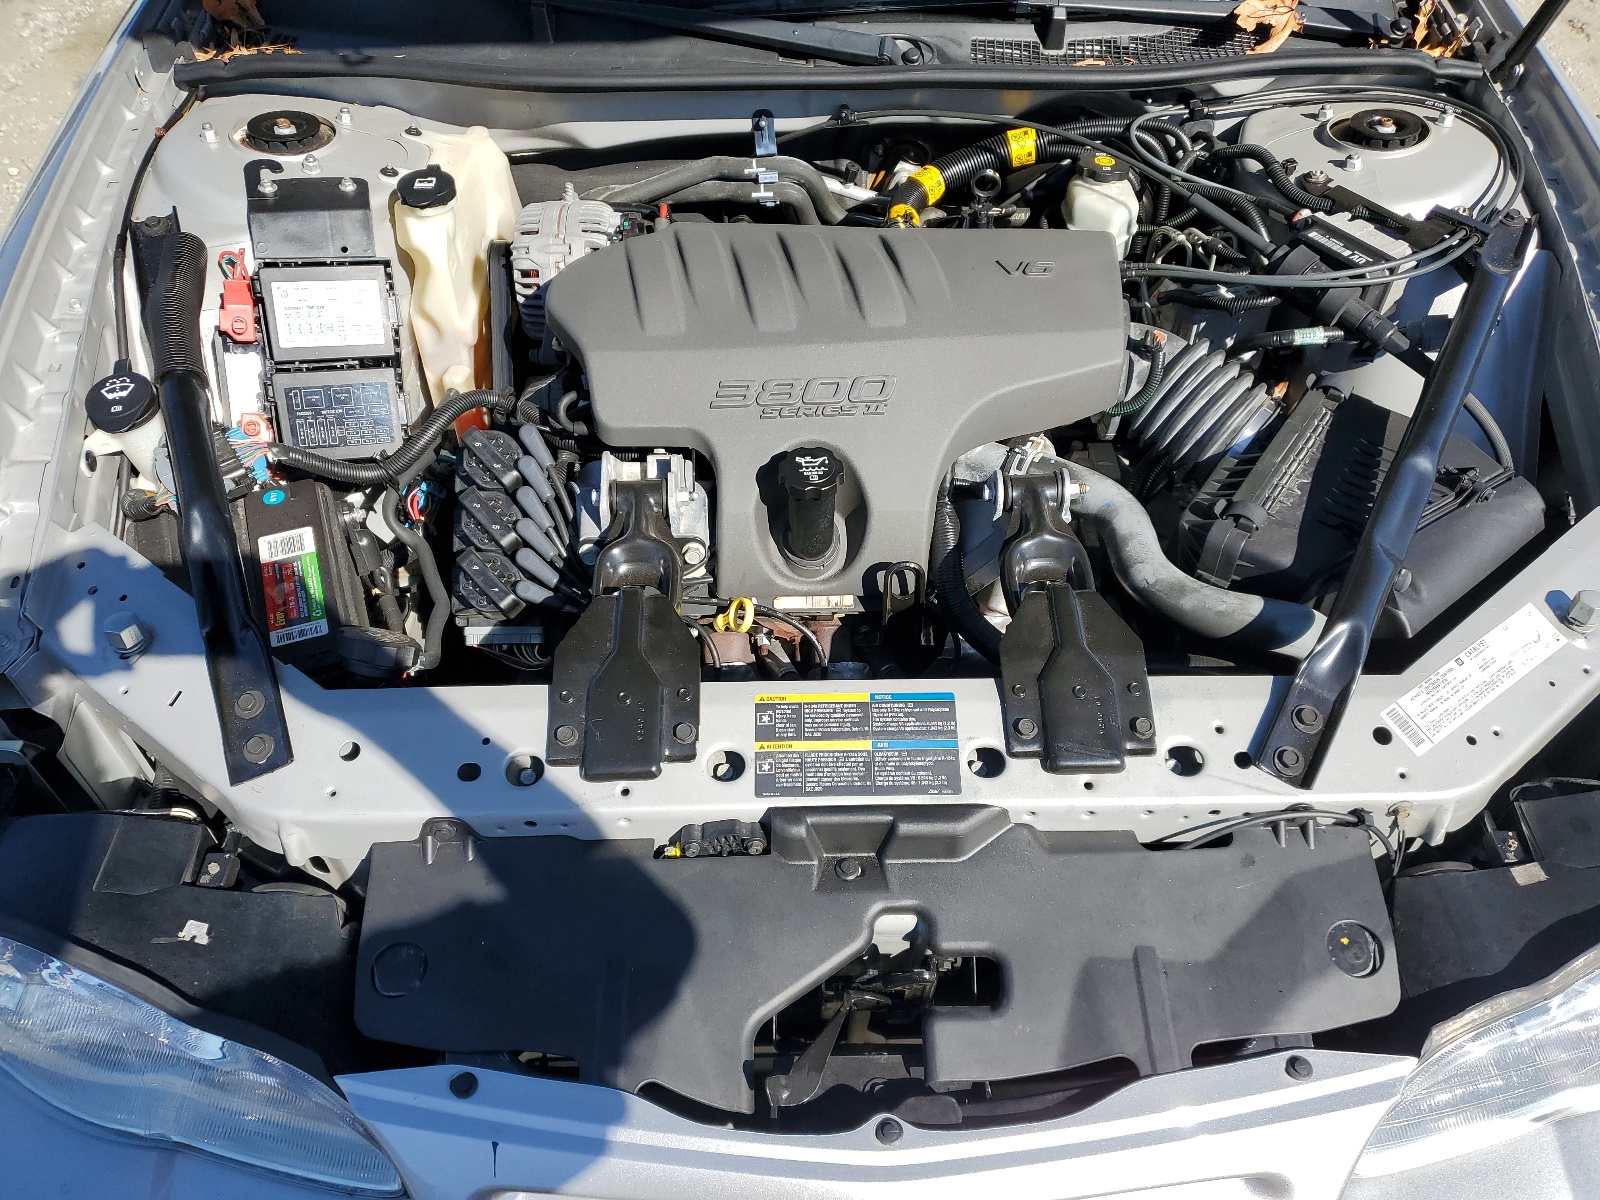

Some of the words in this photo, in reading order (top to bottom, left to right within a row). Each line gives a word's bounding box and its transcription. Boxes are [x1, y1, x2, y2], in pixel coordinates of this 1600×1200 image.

[995, 259, 1055, 278] V6
[709, 374, 898, 410] 3800
[760, 404, 859, 420] SERIES
[862, 403, 888, 416] II
[1463, 638, 1488, 658] CATALYST
